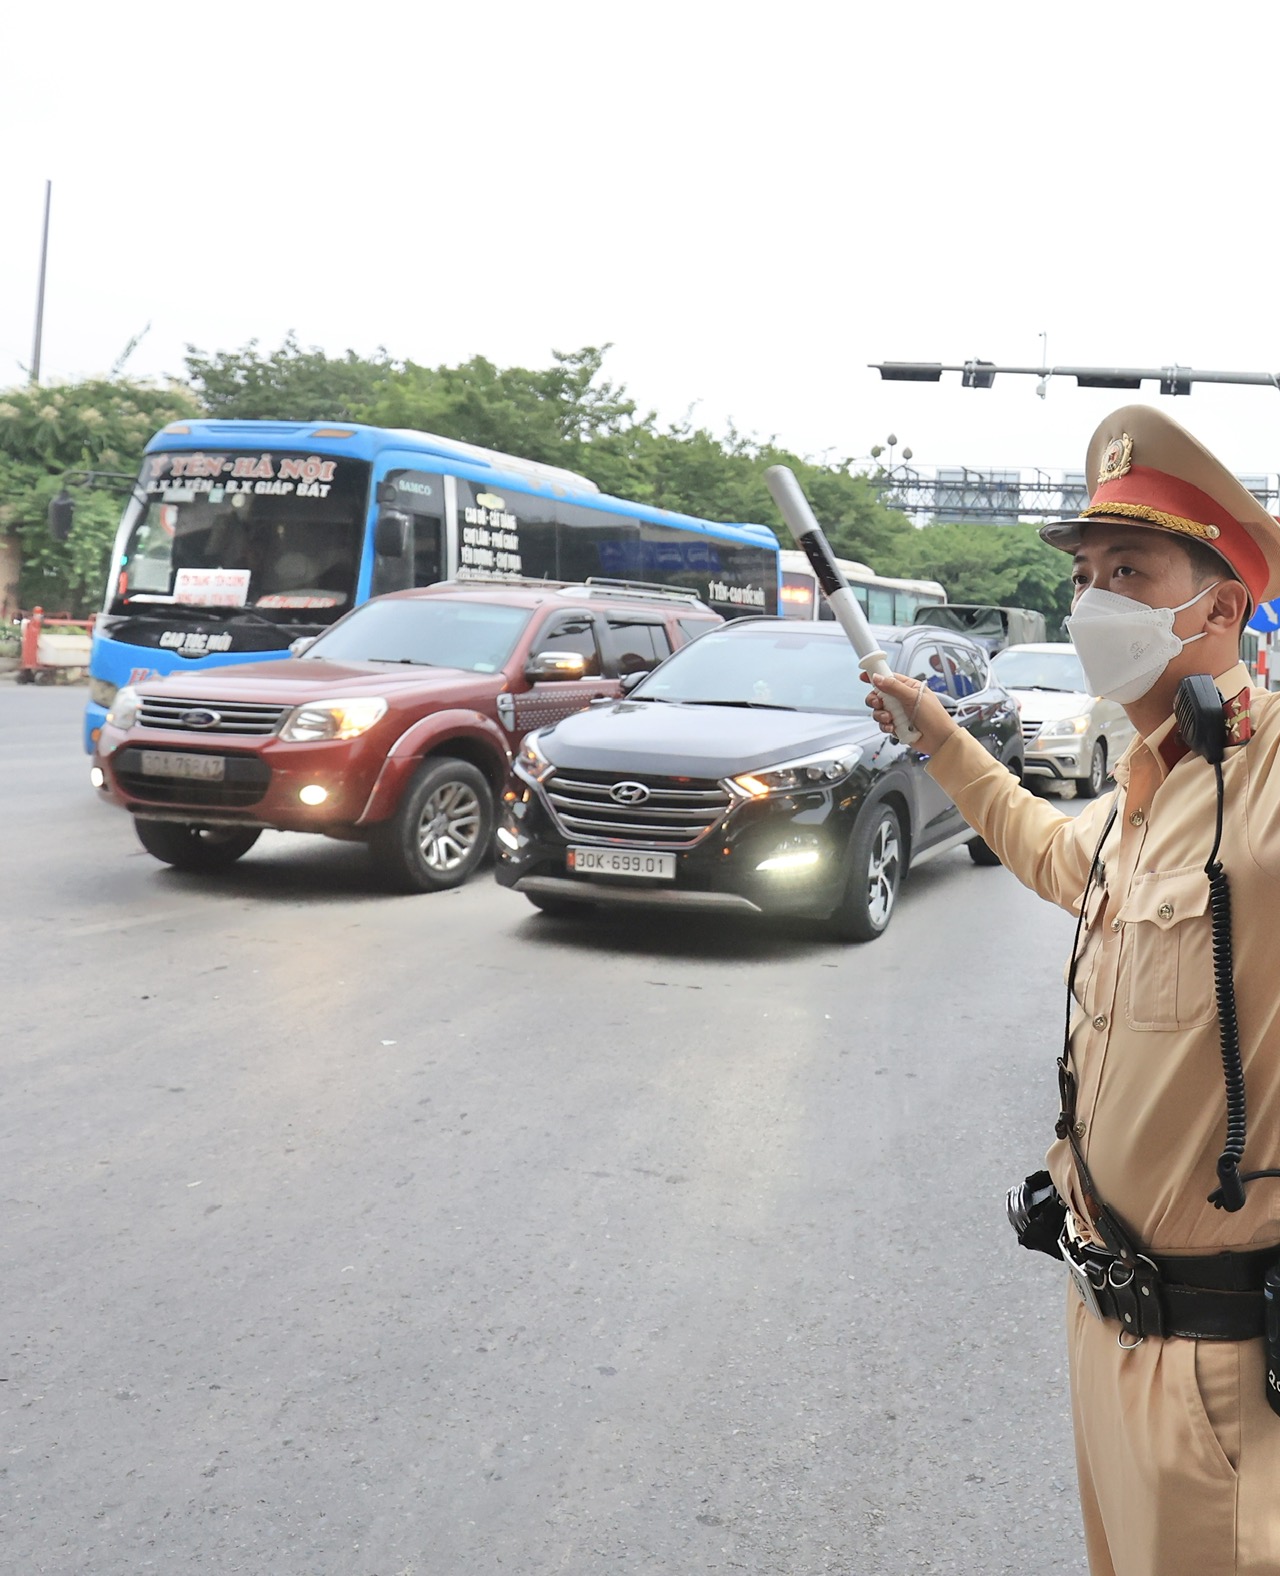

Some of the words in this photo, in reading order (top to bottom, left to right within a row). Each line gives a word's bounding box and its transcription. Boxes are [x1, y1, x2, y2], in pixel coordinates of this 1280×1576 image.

[277, 455, 337, 484] NỘI
[254, 480, 294, 495] GIÁP
[296, 481, 331, 498] BÁT
[399, 480, 432, 496] SAMCO
[159, 631, 185, 648] CAO
[576, 852, 663, 873] 30K-699.01
